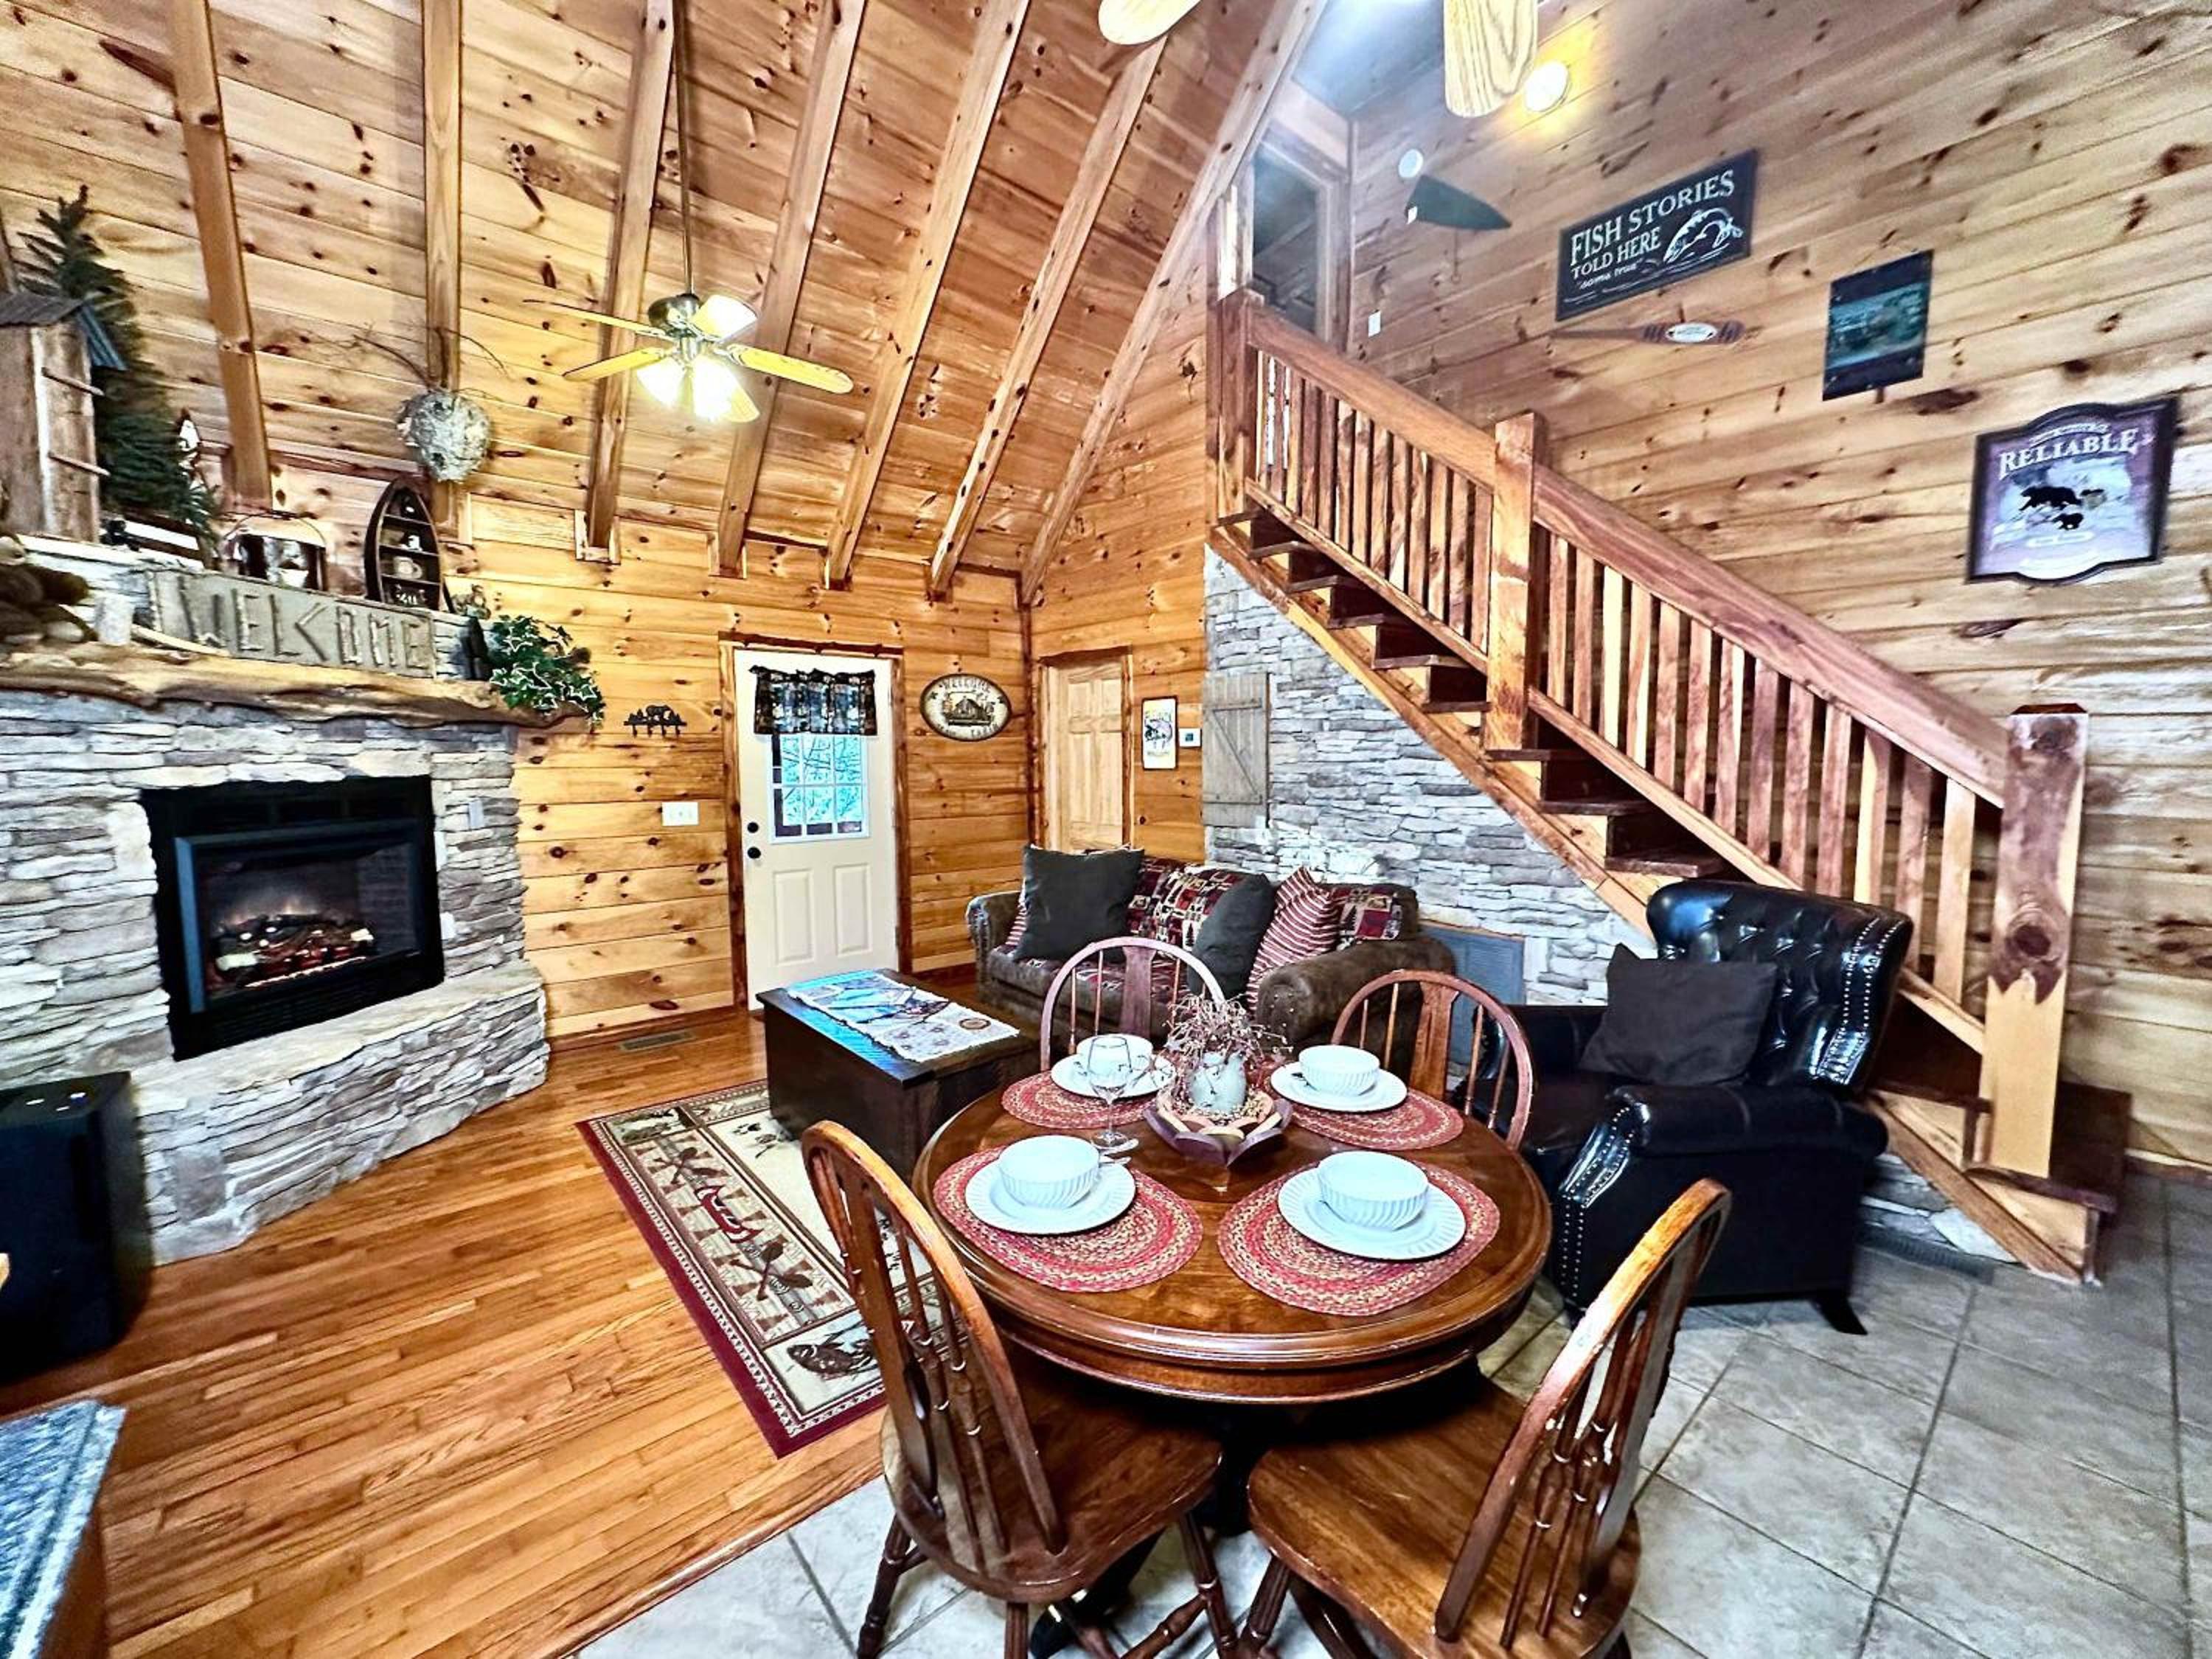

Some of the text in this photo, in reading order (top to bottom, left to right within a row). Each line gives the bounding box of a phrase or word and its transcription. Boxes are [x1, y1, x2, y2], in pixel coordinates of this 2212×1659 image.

[1571, 169, 1735, 266] FISH STORIES
[1571, 226, 1661, 279] TOLD HERE
[1999, 428, 2138, 481] RELIABLE
[178, 574, 430, 669] WELKOME
